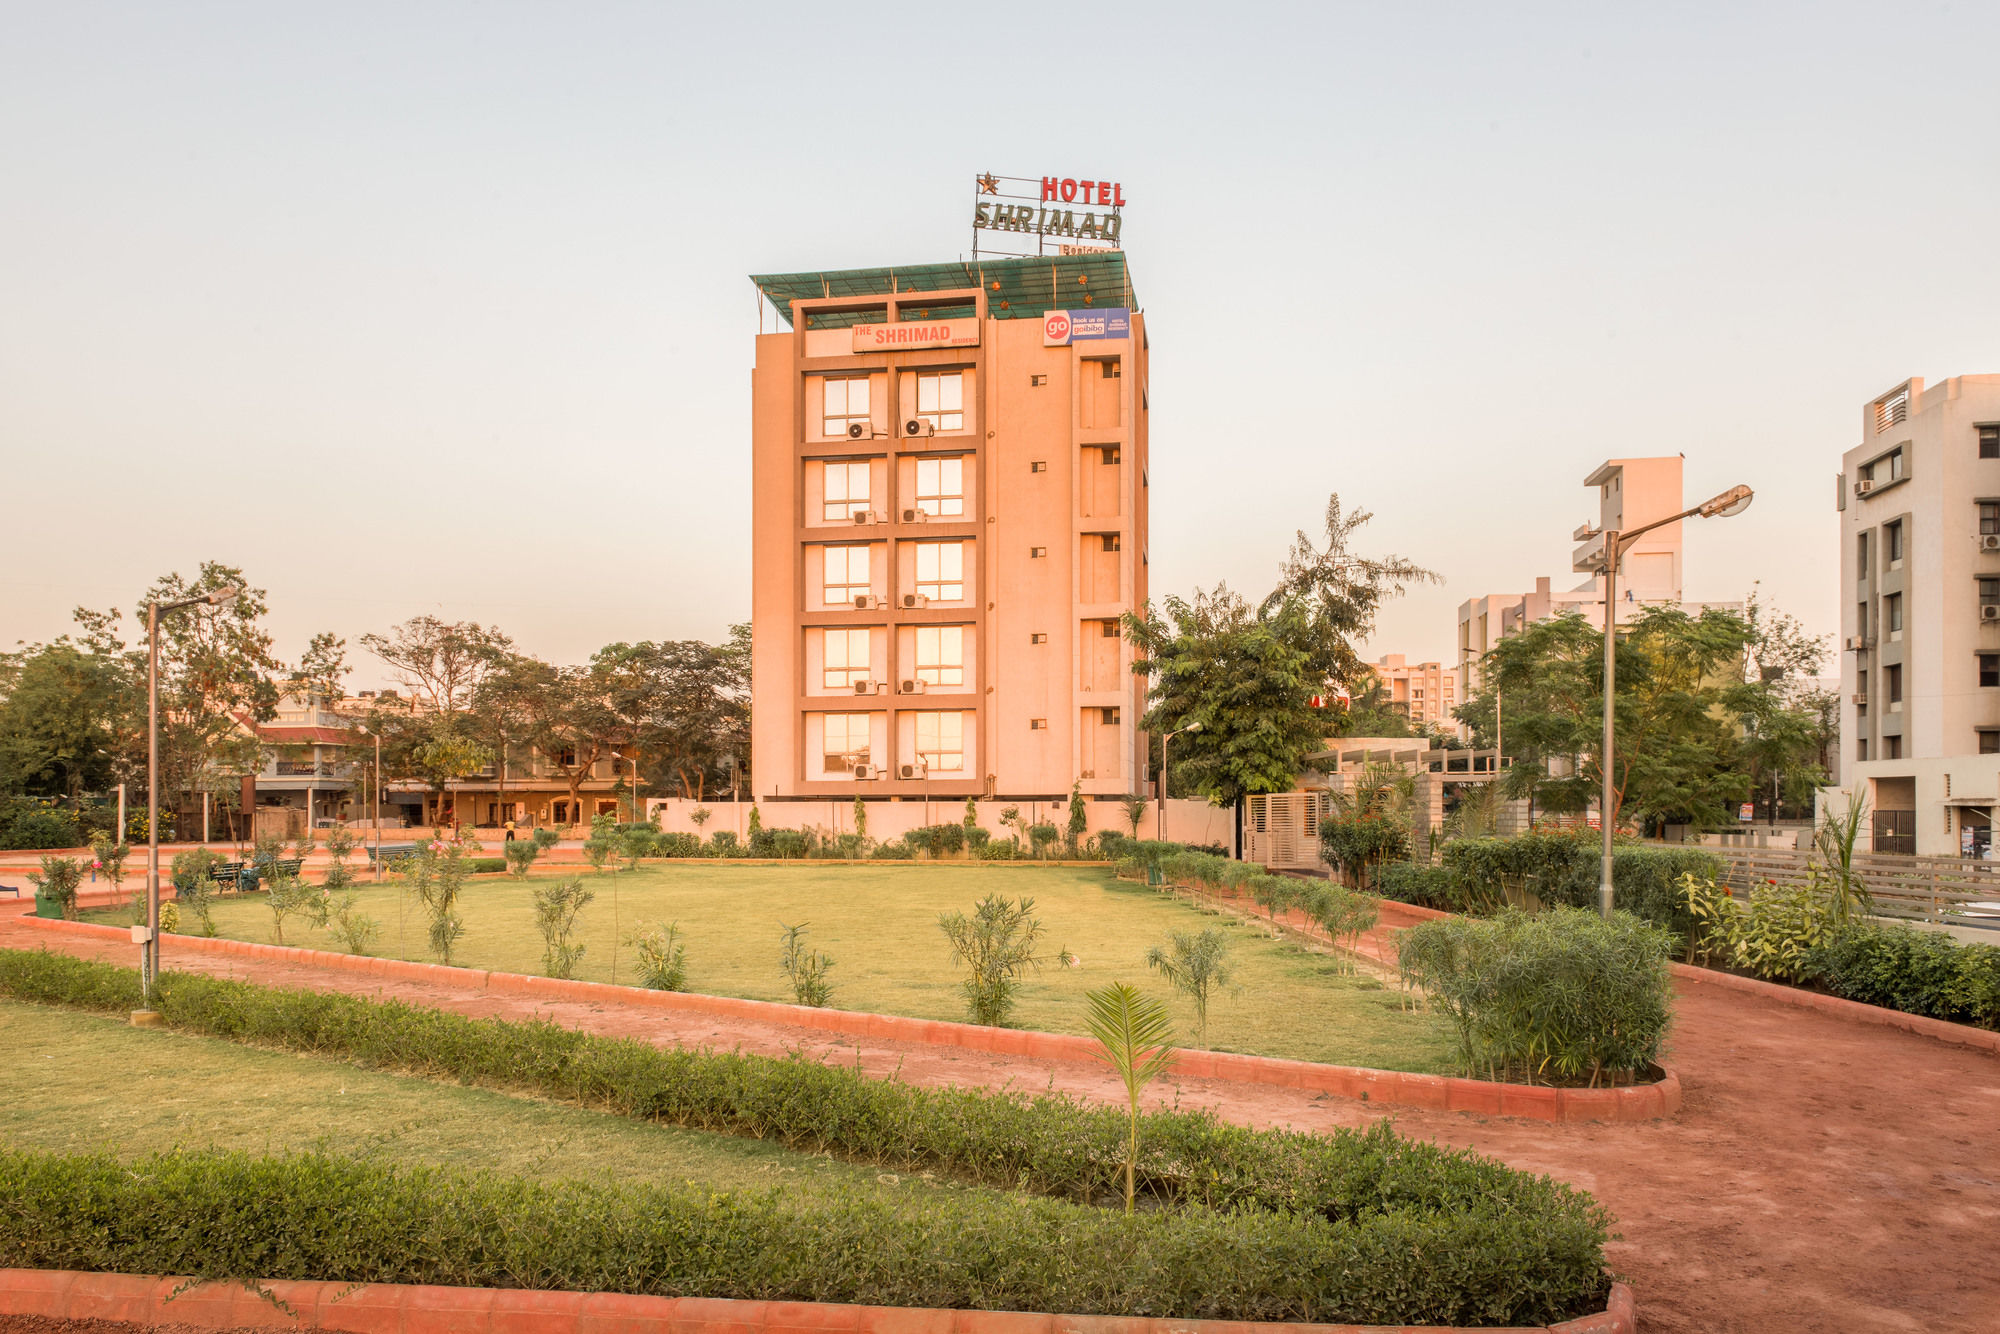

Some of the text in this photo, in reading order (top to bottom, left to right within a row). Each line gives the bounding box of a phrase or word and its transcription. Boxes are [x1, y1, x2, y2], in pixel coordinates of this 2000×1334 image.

[1042, 177, 1126, 206] HOTEL
[973, 202, 1121, 240] SHRIMAD
[854, 326, 872, 336] THE
[875, 326, 951, 344] SHRIMAD
[1048, 321, 1068, 335] go
[1074, 325, 1102, 334] goibibo
